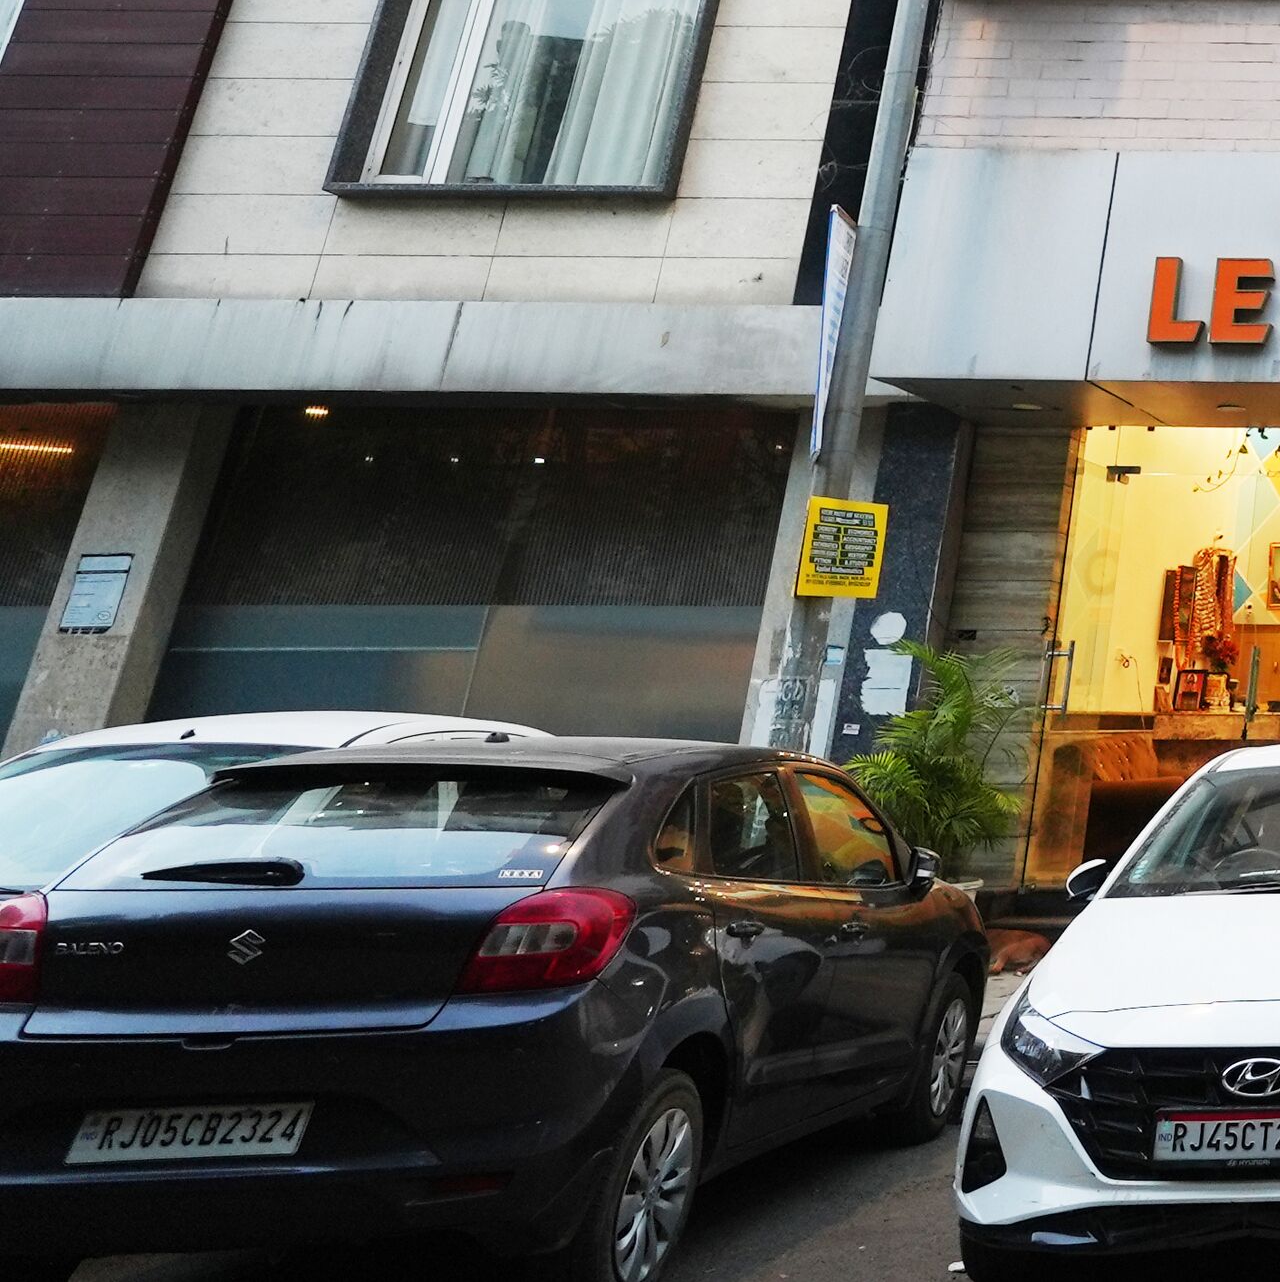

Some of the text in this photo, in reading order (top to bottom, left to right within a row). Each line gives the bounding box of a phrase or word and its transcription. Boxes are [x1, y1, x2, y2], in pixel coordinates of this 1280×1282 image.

[1147, 256, 1276, 345] LE
[56, 942, 125, 955] BALENO
[98, 1109, 302, 1150] RJ05CB2324
[1158, 1133, 1172, 1143] IND
